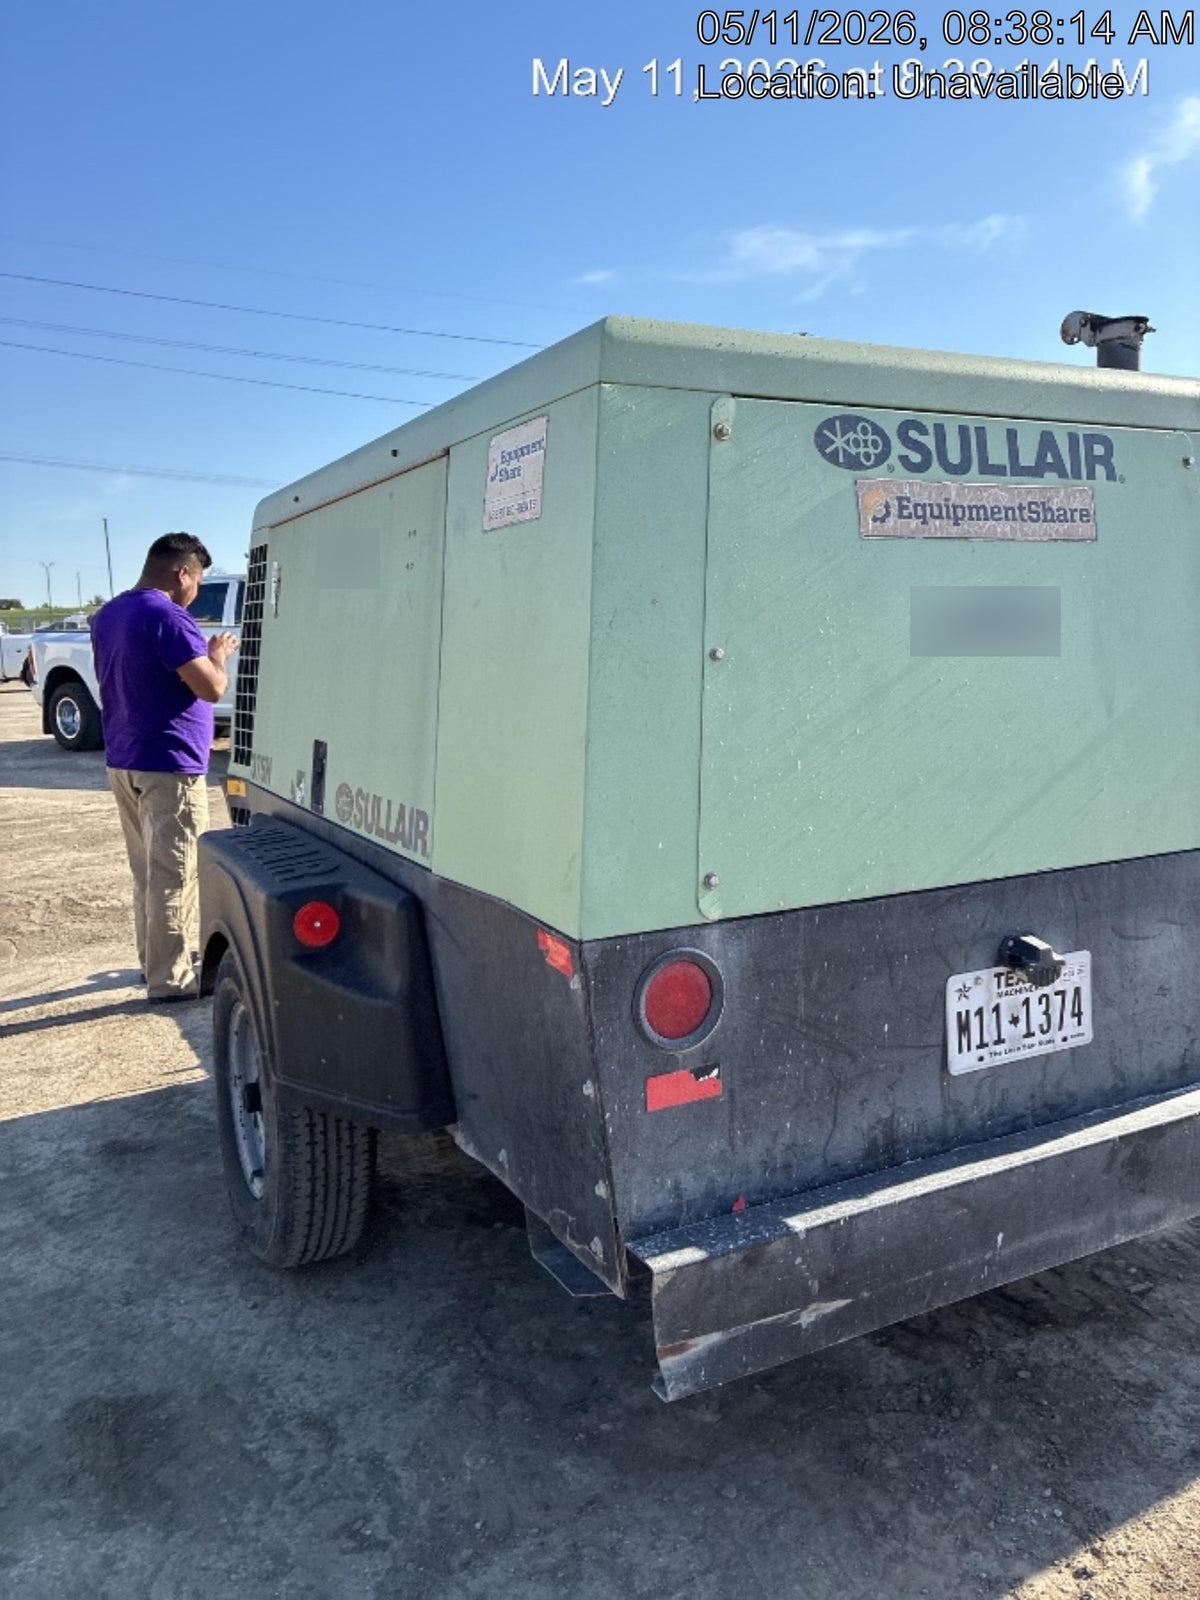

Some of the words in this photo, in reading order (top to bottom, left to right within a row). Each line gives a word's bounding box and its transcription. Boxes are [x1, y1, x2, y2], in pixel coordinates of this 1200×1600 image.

[897, 418, 1118, 482] SULLAIR
[896, 494, 1092, 526] EquipmentShare
[353, 787, 430, 858] SULLAIR
[956, 1002, 1006, 1055] M11
[1021, 986, 1084, 1039] 1374
[996, 984, 1039, 999] MACHINE
